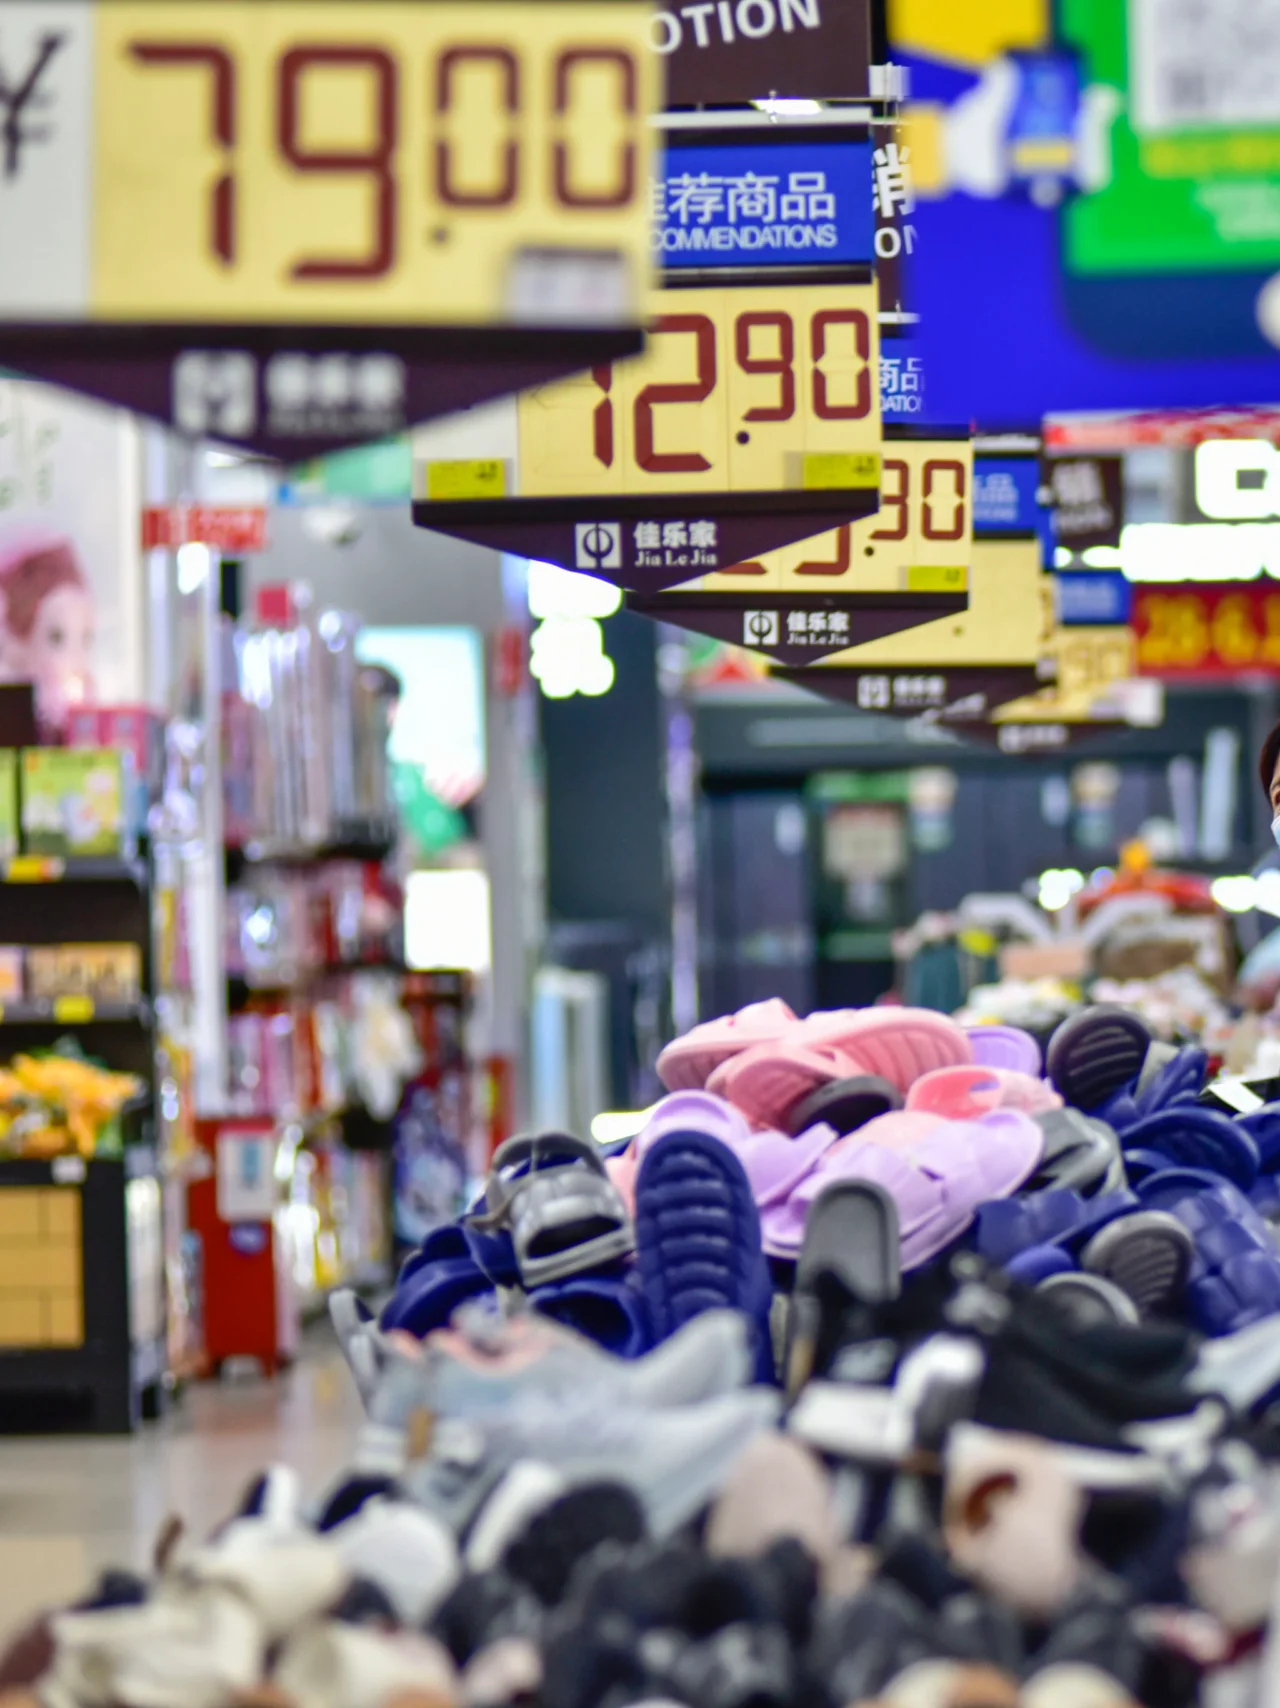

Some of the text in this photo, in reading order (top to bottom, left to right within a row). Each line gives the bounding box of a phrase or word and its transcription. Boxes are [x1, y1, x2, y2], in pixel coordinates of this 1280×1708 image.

[124, 40, 638, 285] 79.00
[592, 309, 870, 474] 12.90
[633, 520, 717, 549] 佳乐家
